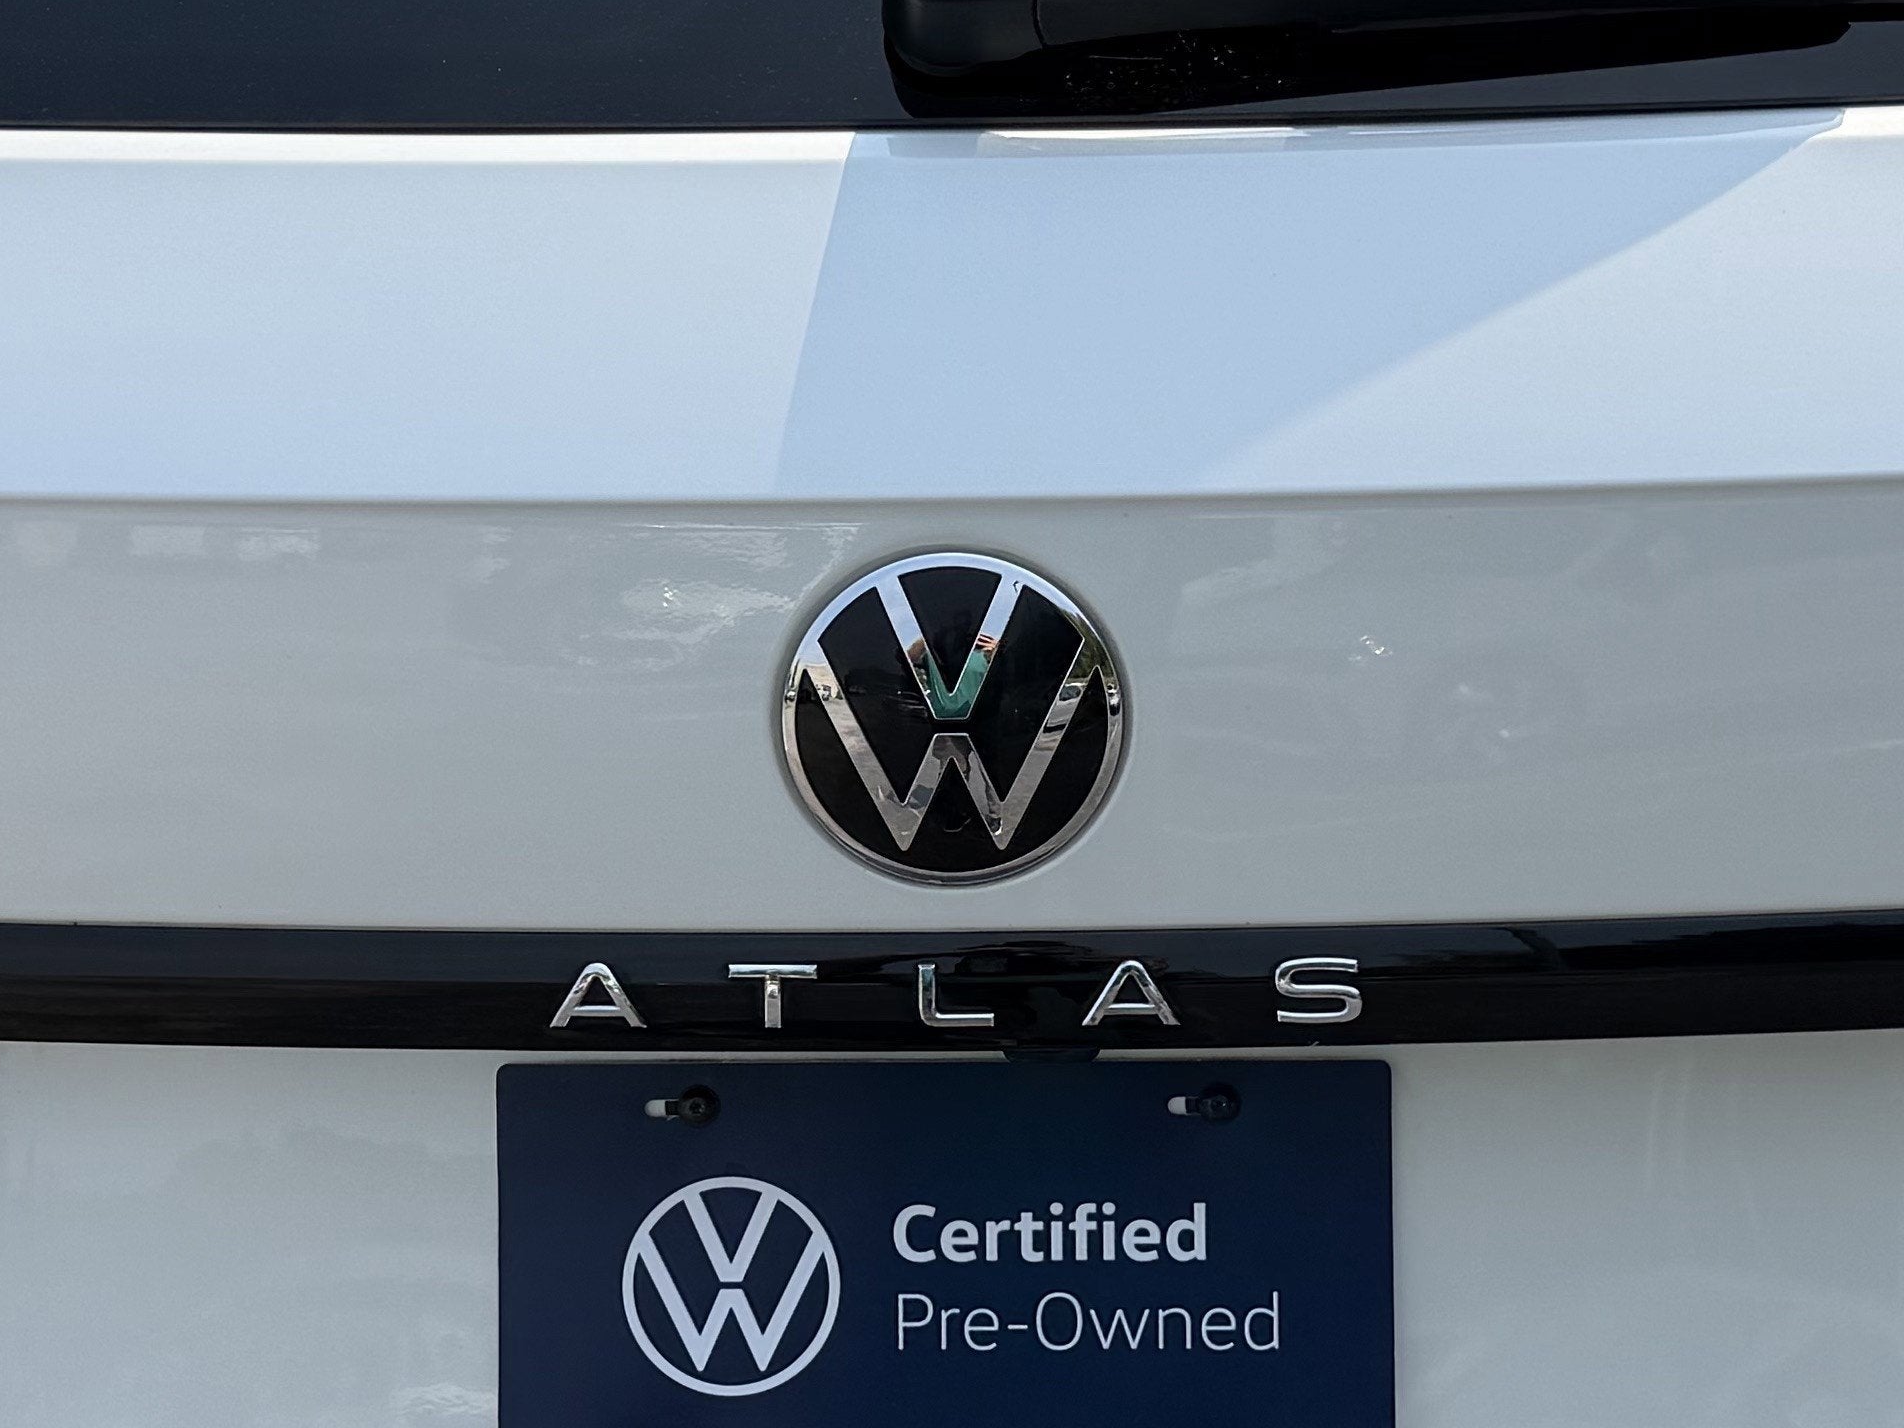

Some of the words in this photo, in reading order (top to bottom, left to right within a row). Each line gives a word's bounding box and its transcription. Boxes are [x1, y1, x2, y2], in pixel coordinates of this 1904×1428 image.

[548, 956, 1364, 1030] ATLAS
[893, 1202, 1209, 1264] Certified
[896, 1290, 1281, 1352] Pre-Owned
